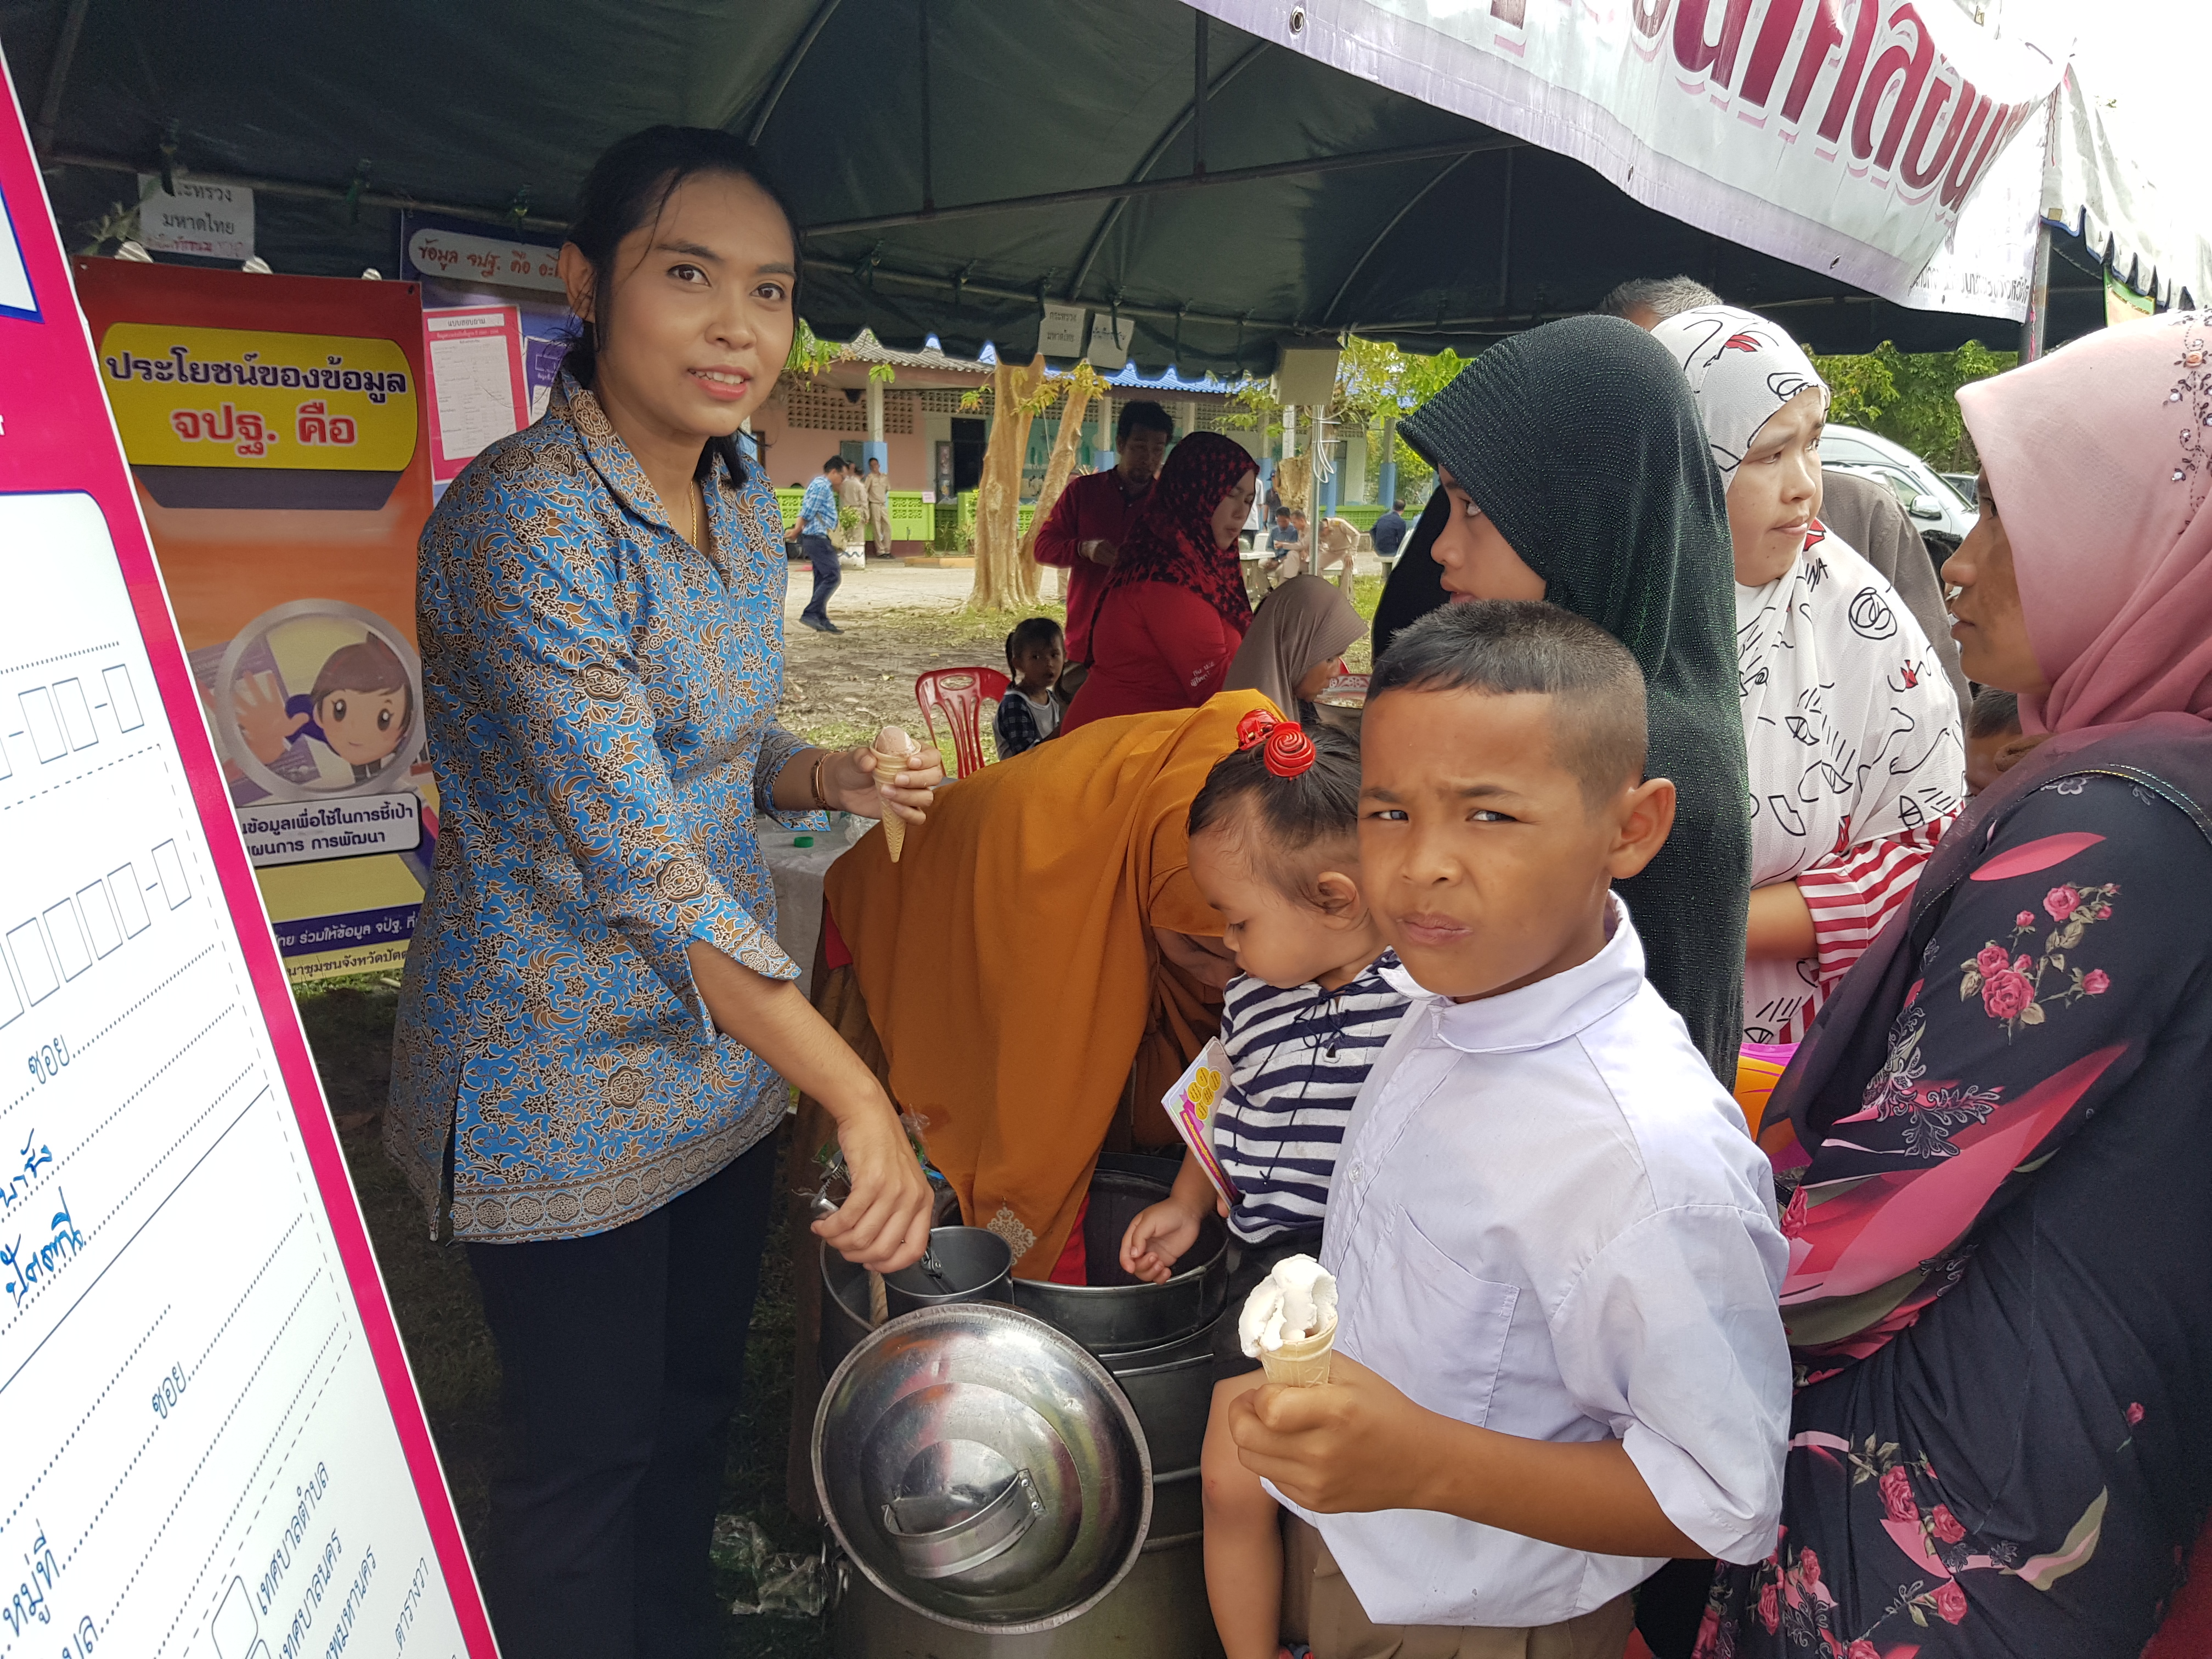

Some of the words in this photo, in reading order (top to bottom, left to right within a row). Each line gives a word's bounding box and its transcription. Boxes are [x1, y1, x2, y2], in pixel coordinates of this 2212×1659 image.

[176, 184, 232, 202] ะทรวง
[105, 347, 407, 403] ประโยชน์ของข้อมูล
[172, 404, 276, 455] จปฐ.
[298, 401, 356, 445] คือ
[247, 839, 304, 856] ผนการ
[312, 831, 386, 850] การพัฒนา
[276, 934, 294, 947] ทย
[299, 924, 371, 944] ร่วมให้ข้อมูล
[375, 917, 403, 934] จปฐ.
[28, 1034, 70, 1084] ซอย
[151, 1361, 187, 1420] ซอย
[257, 1462, 329, 1616] เทศบาลตำบล
[3, 1518, 60, 1638] หมู่ที่
[278, 1528, 342, 1659] ทศบาลนคร
[395, 1557, 428, 1651] ตารางวา
